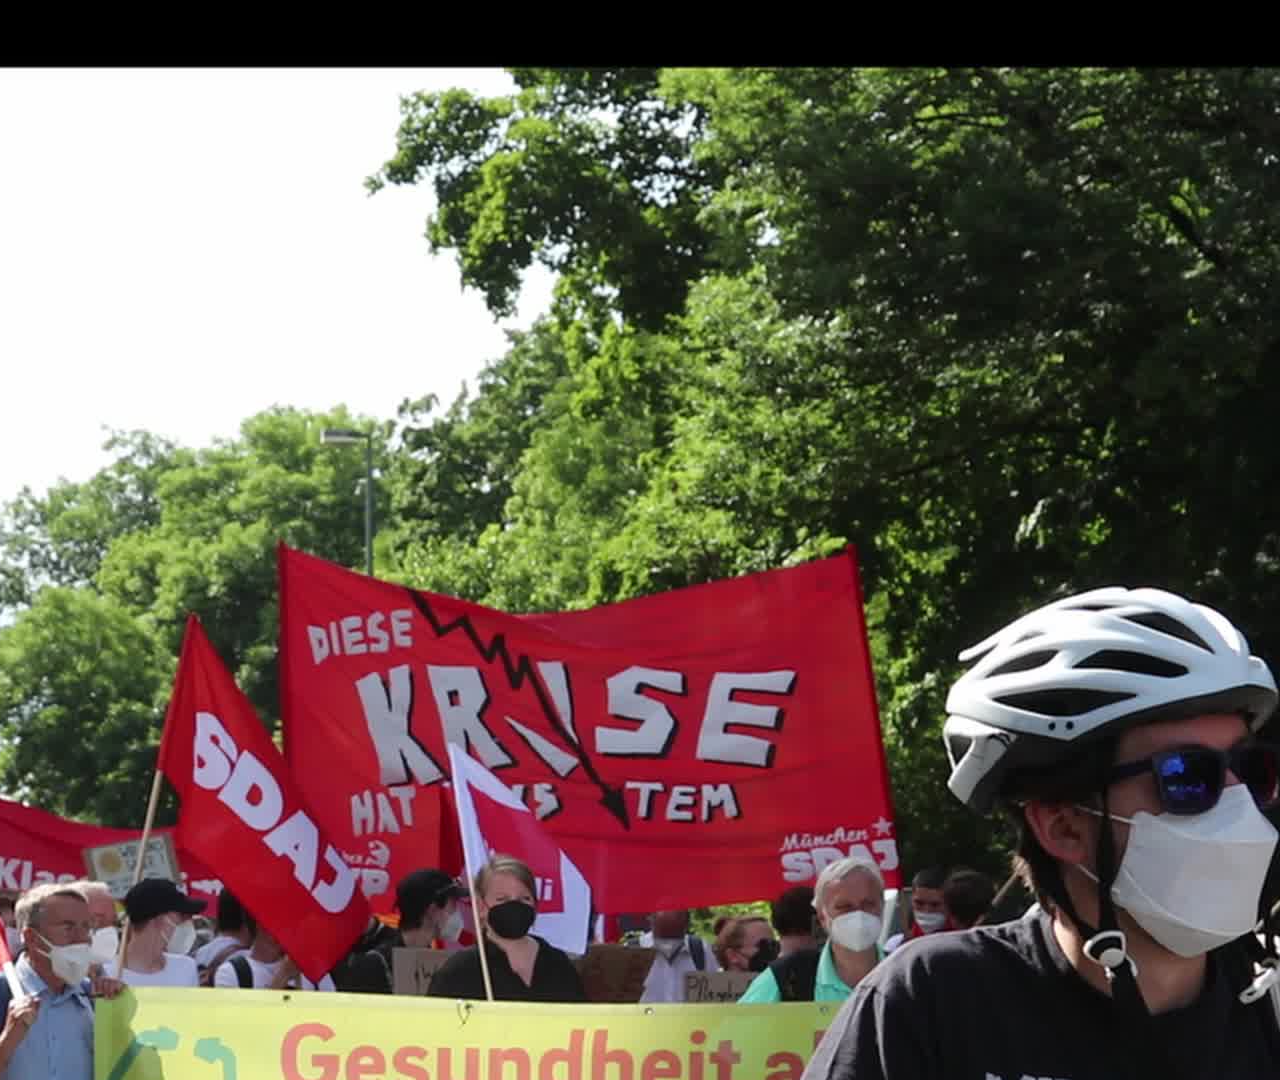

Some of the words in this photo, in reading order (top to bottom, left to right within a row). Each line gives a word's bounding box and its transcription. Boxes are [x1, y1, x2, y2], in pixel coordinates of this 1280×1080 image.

[306, 609, 414, 665] DIESE
[355, 661, 797, 786] KRISE
[193, 711, 356, 913] SDAJ
[351, 784, 416, 837] HAT
[780, 826, 869, 852] München
